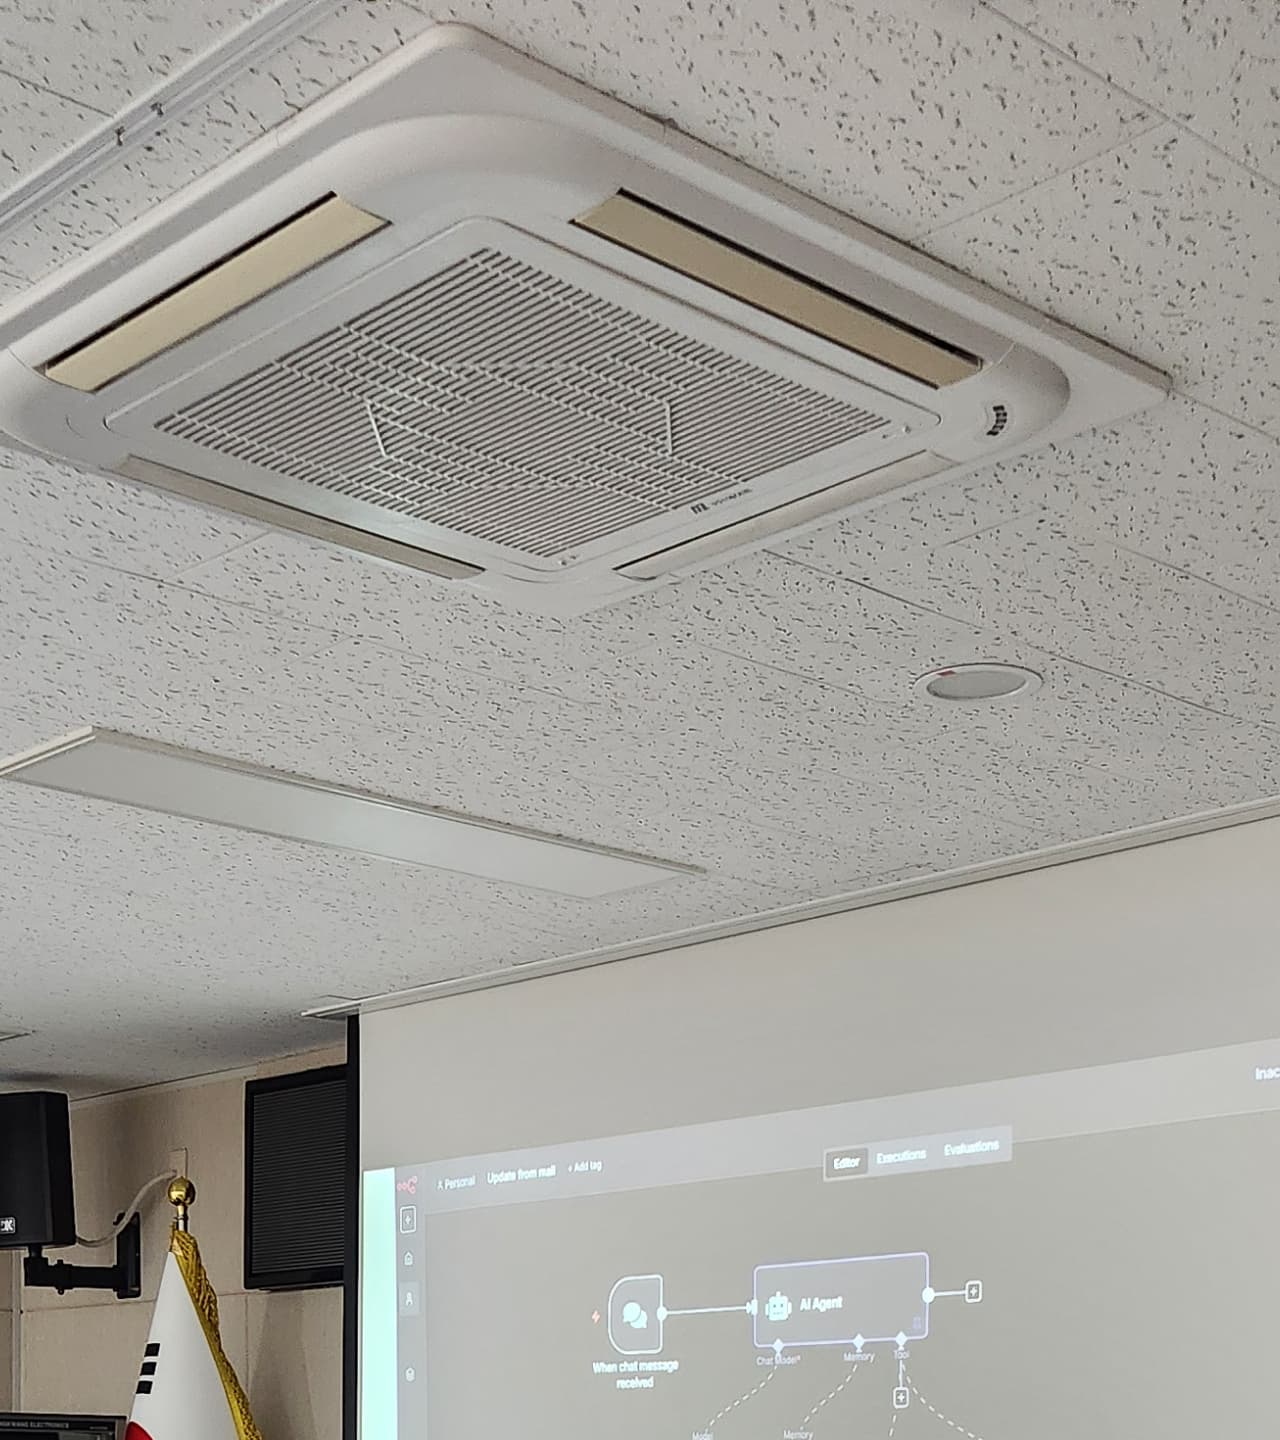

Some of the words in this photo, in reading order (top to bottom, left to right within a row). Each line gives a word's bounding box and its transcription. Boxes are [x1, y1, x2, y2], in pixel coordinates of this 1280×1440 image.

[833, 1156, 860, 1169] Editor
[876, 1149, 927, 1164] Executions
[943, 1140, 1000, 1157] Evaluations
[574, 1161, 589, 1173] Add
[590, 1160, 602, 1173] tag
[487, 1170, 516, 1185] Update
[517, 1167, 537, 1180] from
[538, 1164, 556, 1177] mail
[444, 1174, 476, 1191] Personal
[799, 1297, 810, 1311] AI
[811, 1296, 843, 1311] Agent
[843, 1350, 876, 1363] Memory
[894, 1348, 910, 1360] Tool
[756, 1355, 775, 1367] Chat
[592, 1362, 618, 1374] When
[619, 1361, 638, 1373] chat
[639, 1360, 679, 1376] message
[616, 1377, 654, 1389] received
[692, 1431, 713, 1440] Model
[783, 1430, 814, 1440] Memory
